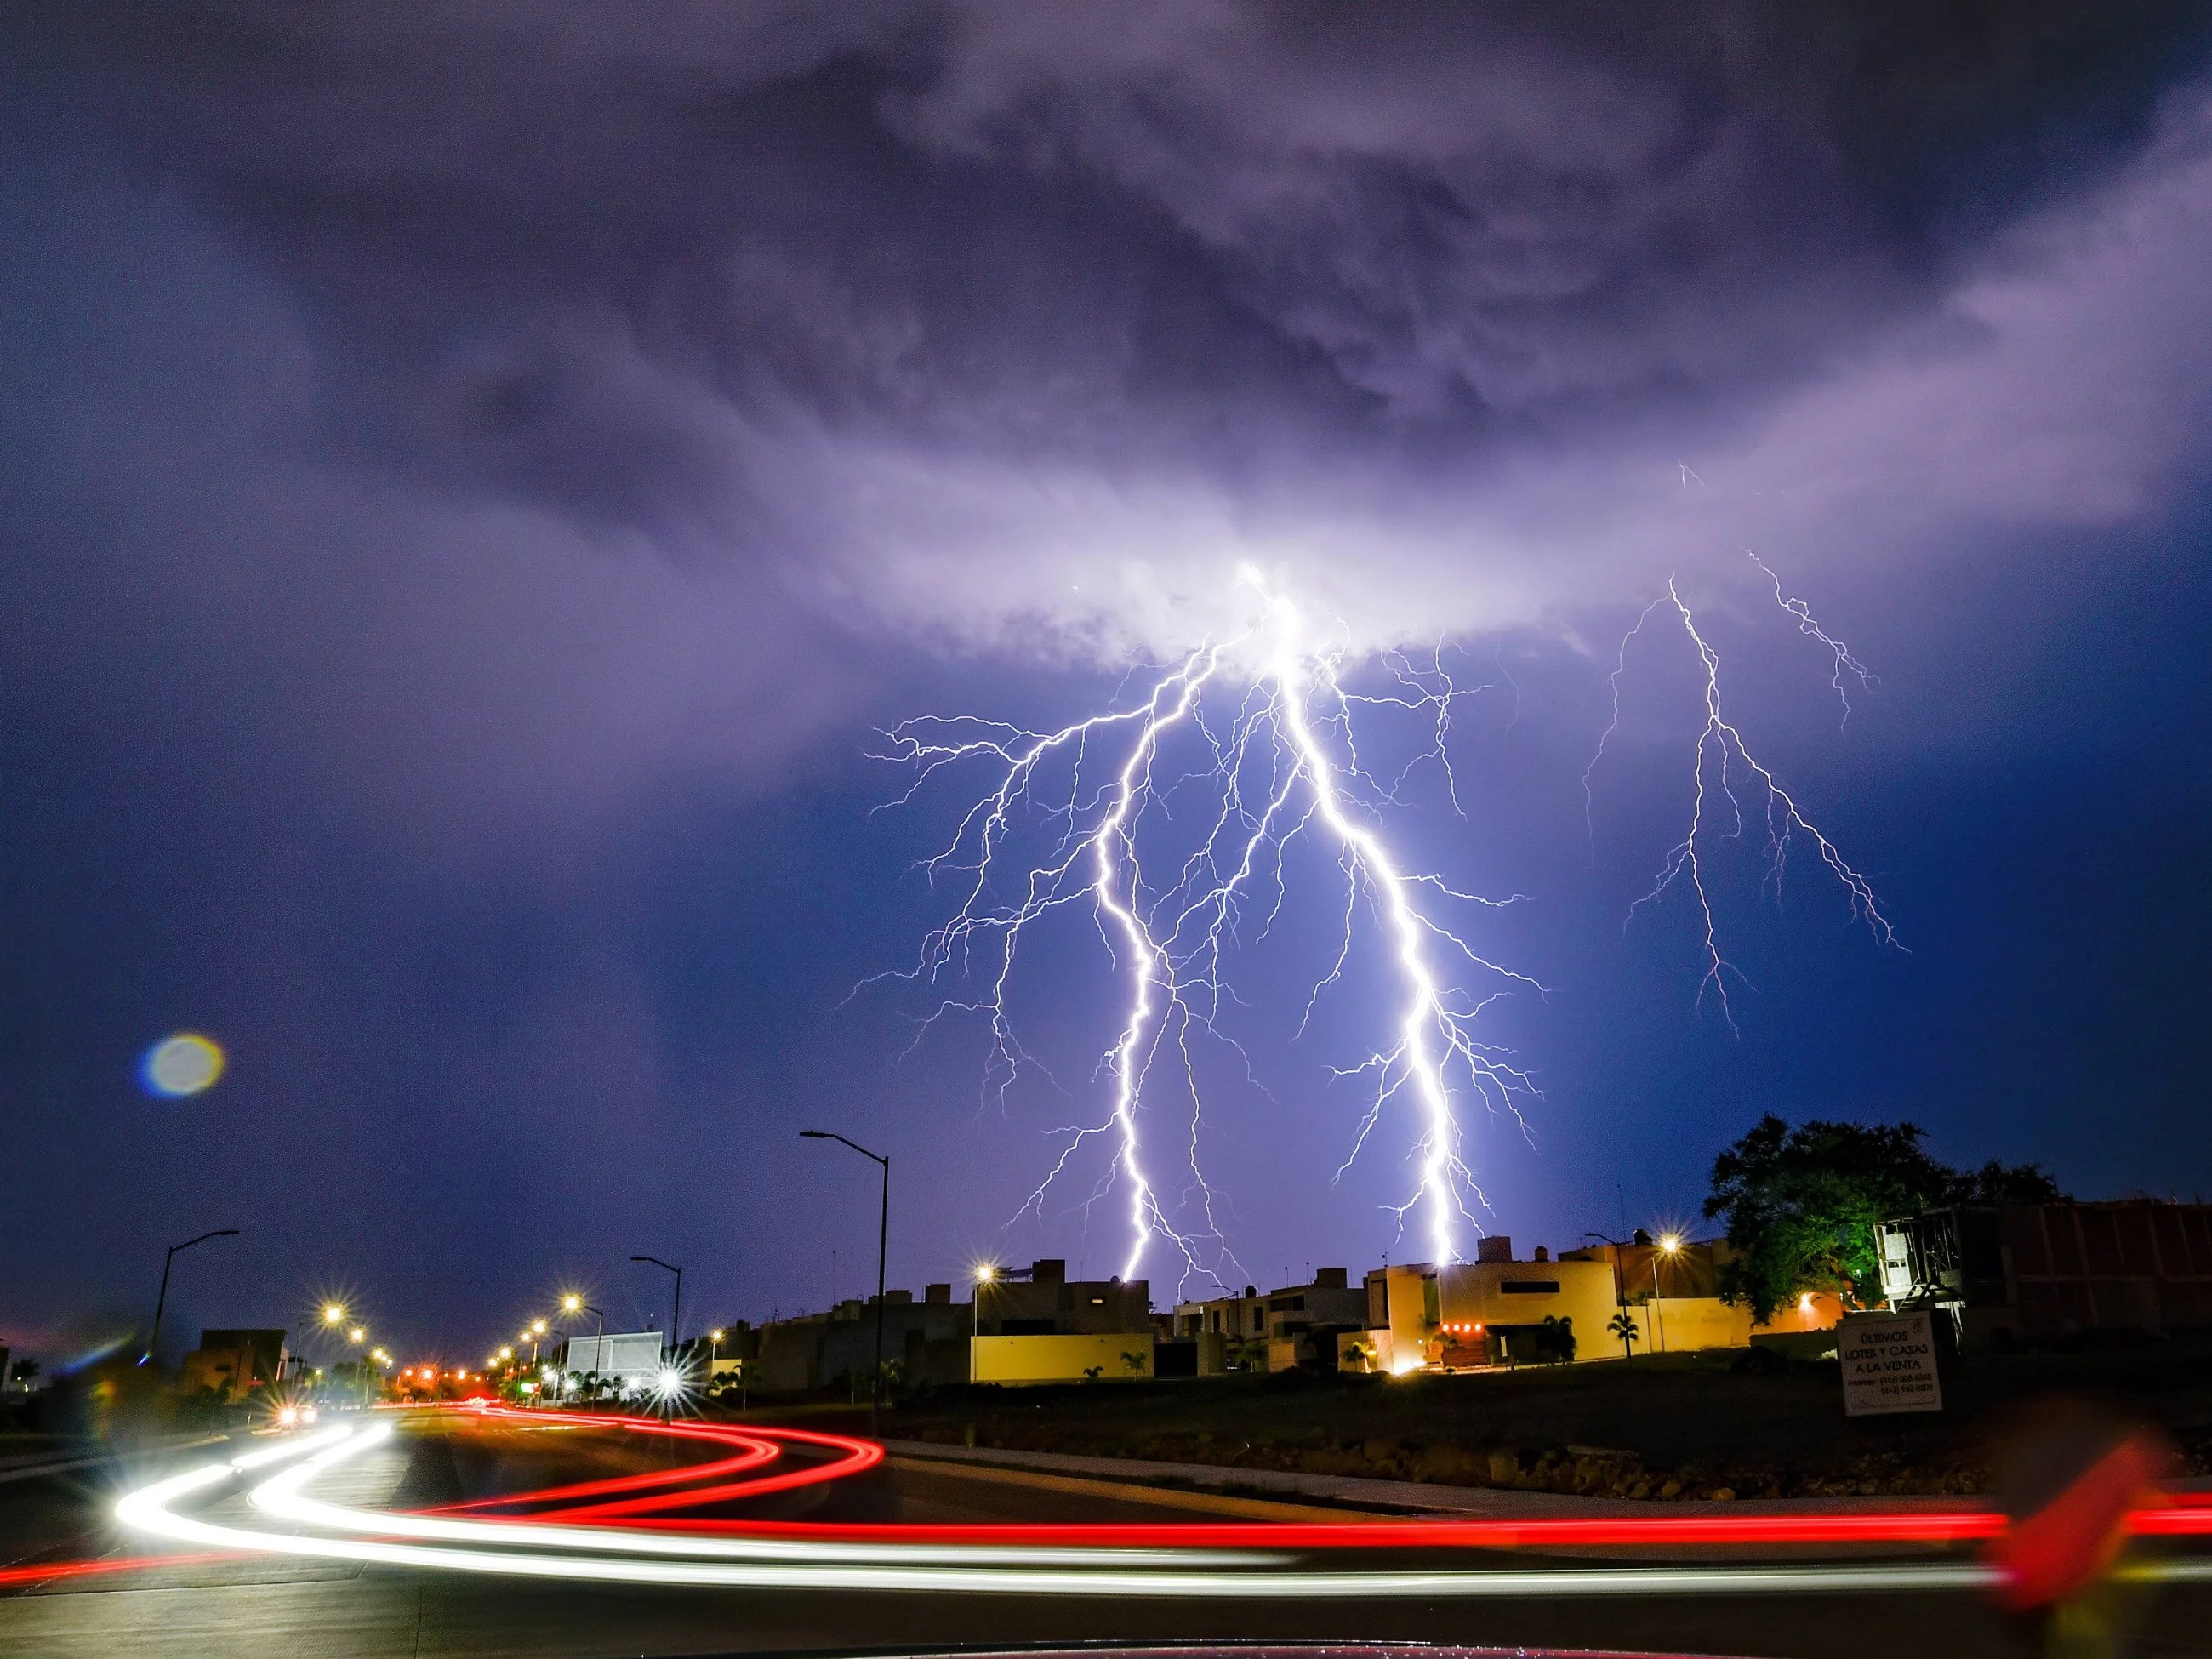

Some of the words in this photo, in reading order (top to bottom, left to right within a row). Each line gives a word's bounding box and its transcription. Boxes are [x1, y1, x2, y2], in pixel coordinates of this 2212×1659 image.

[1844, 1348, 1877, 1360] LOTES
[1879, 1347, 1887, 1357] Y
[1890, 1343, 1929, 1356] CASAS
[1856, 1363, 1865, 1373] A
[1867, 1363, 1881, 1373] LA
[1883, 1360, 1922, 1371] VENTA
